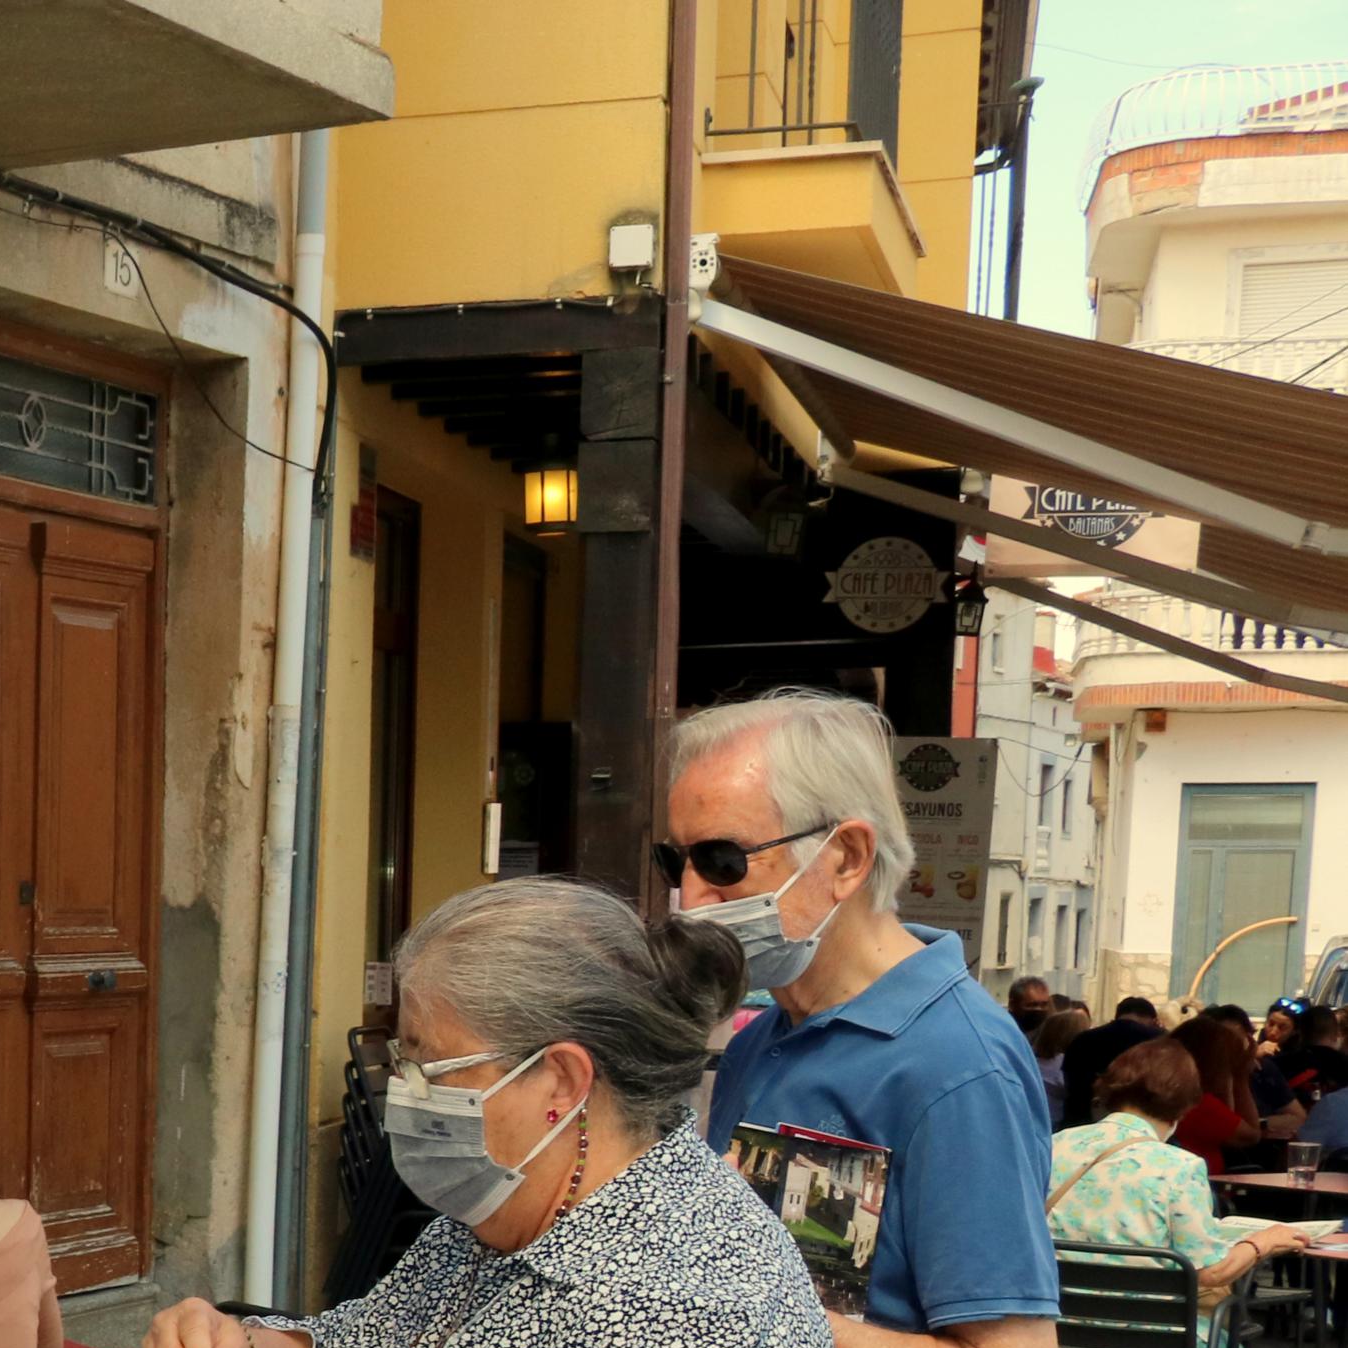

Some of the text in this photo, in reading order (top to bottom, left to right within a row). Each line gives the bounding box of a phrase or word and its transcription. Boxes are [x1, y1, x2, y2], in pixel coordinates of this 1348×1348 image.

[112, 250, 131, 287] 15
[885, 572, 933, 594] PLAZA
[905, 802, 963, 817] SAYUNOS
